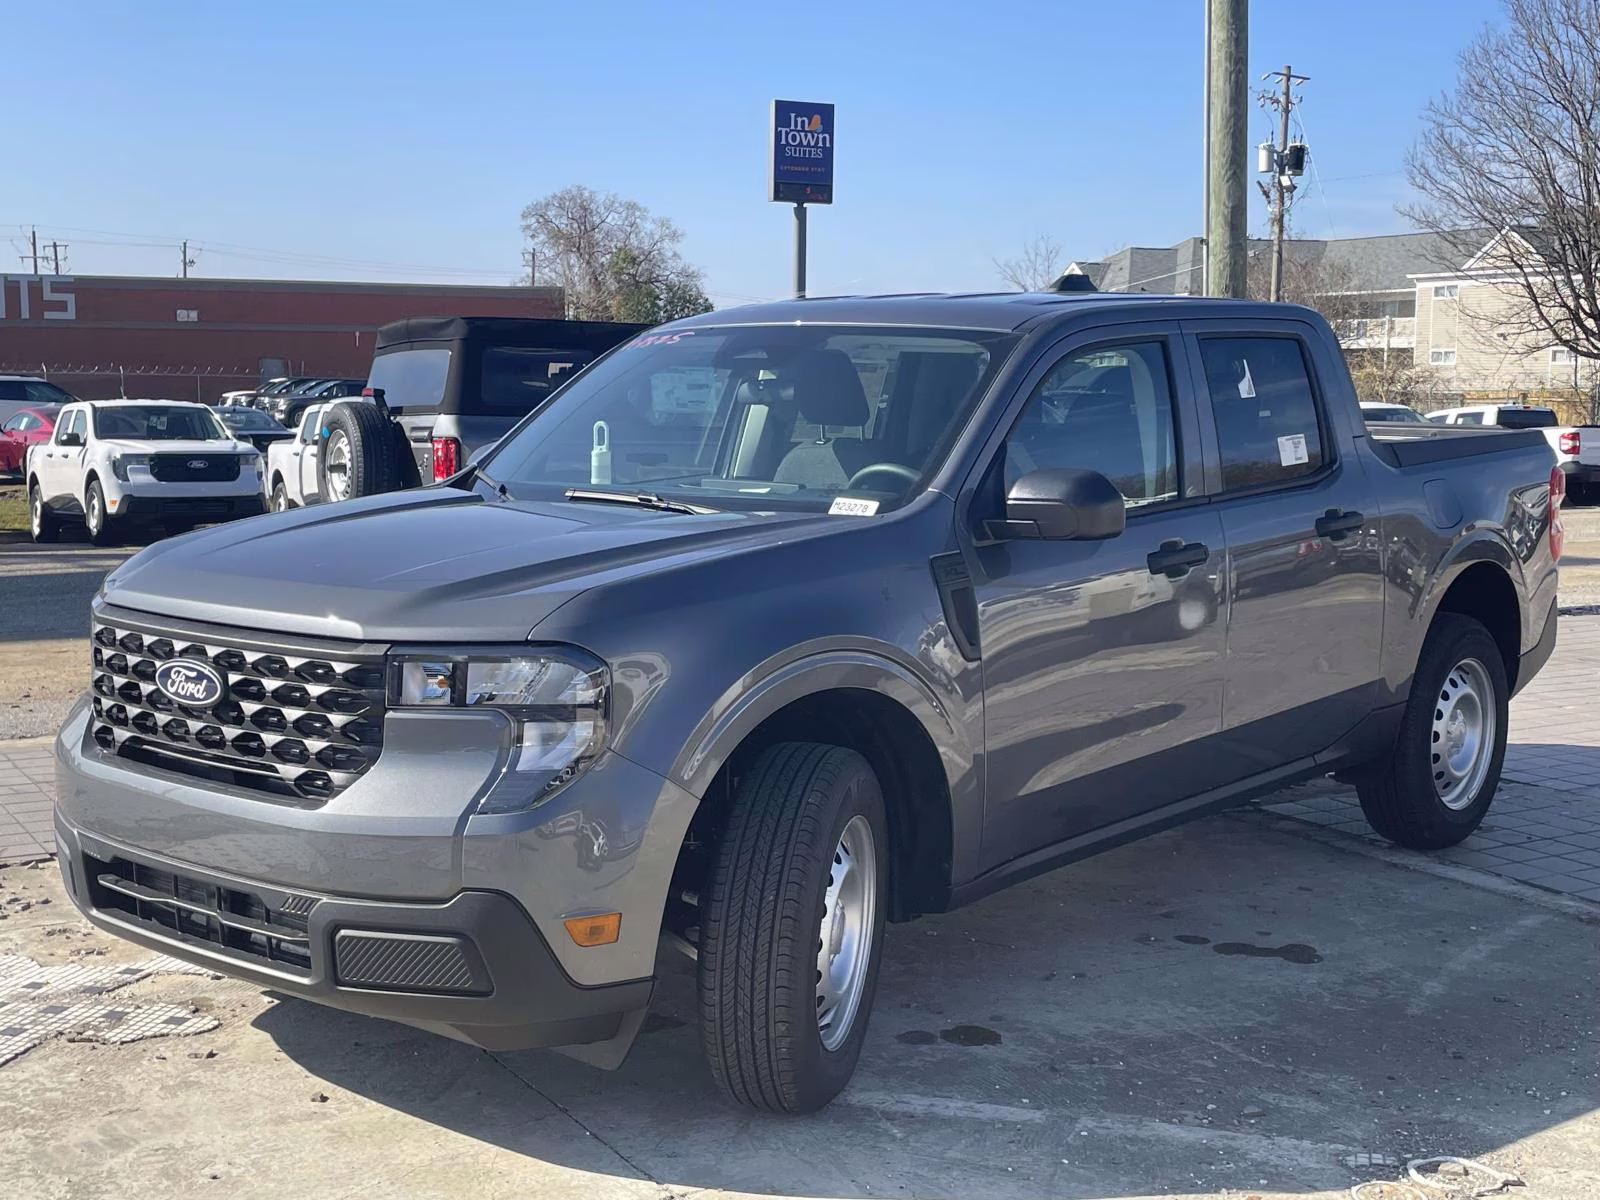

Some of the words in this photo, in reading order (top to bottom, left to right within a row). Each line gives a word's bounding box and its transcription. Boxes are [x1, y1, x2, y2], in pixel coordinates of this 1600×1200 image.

[789, 113, 809, 131] In
[785, 146, 823, 158] SUITES
[833, 502, 869, 513] M23278
[167, 667, 208, 699] Ford
